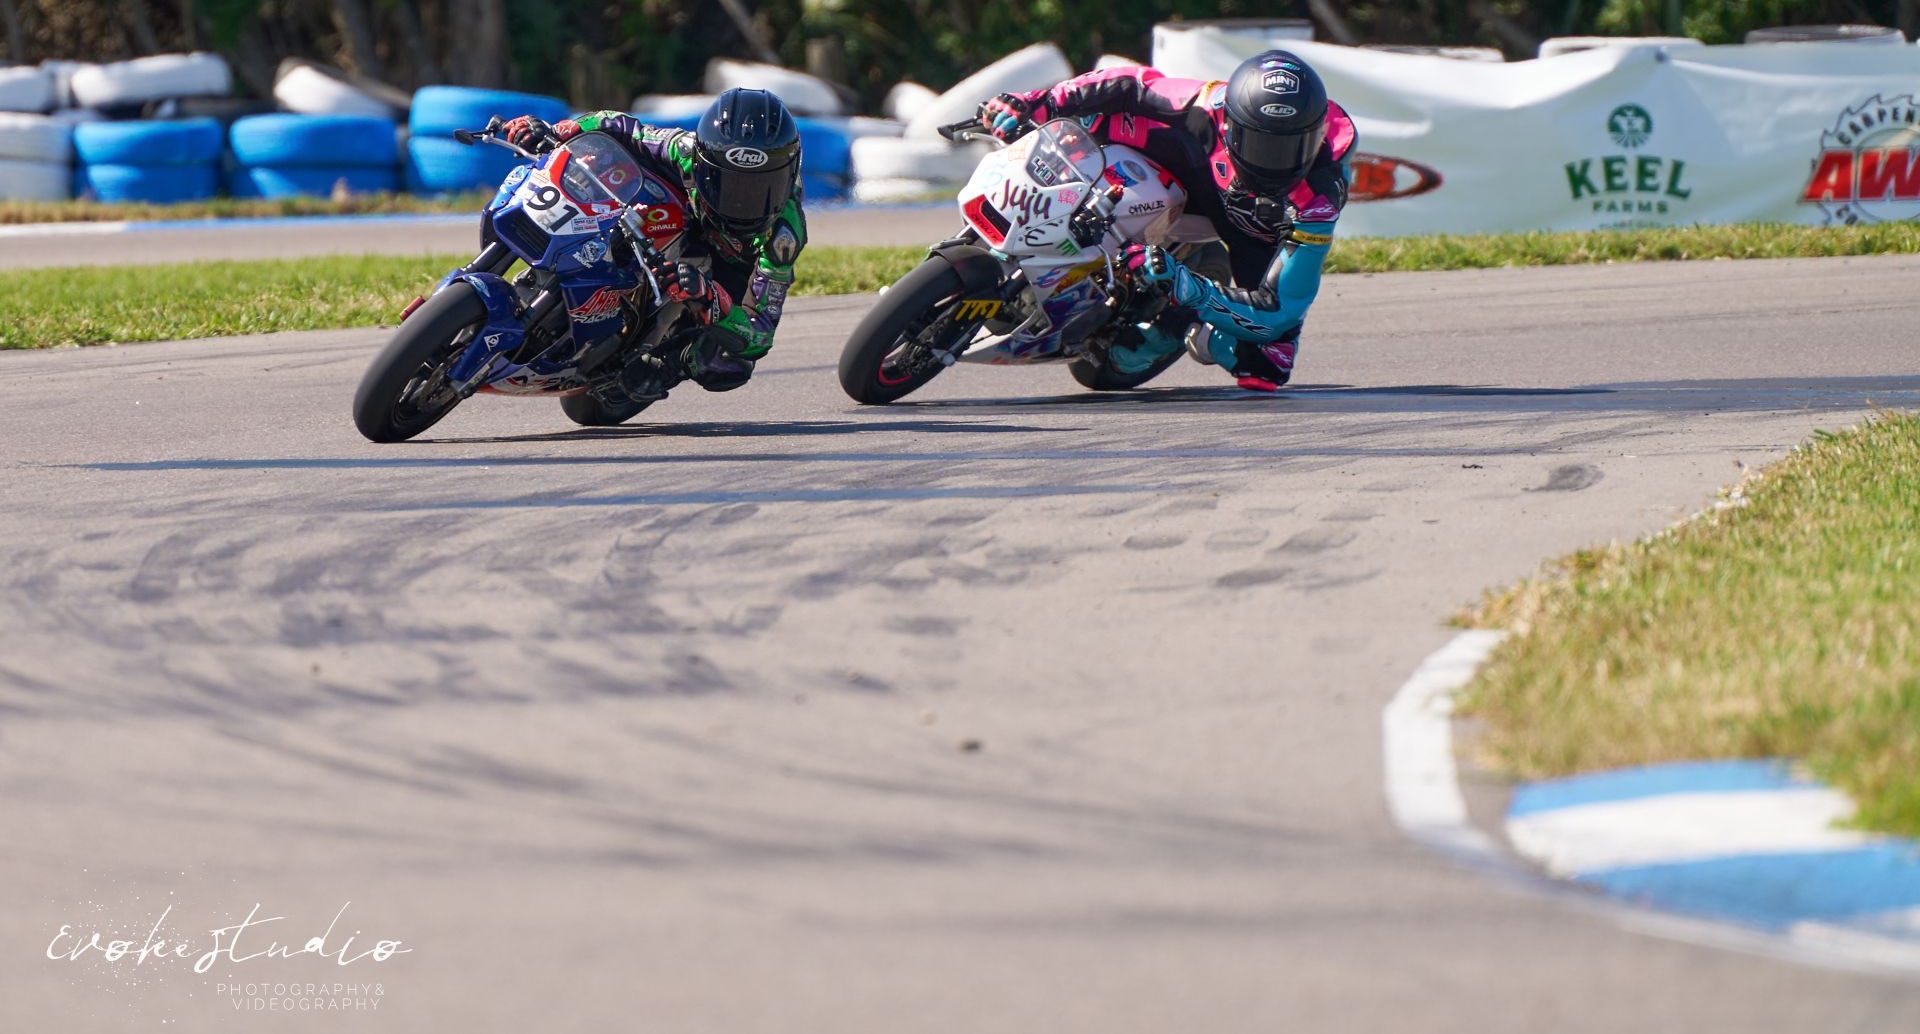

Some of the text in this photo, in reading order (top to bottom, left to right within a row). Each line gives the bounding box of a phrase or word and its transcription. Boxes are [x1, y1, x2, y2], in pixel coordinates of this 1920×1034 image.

[1265, 75, 1296, 88] MINT
[1265, 105, 1292, 114] HJC
[729, 149, 764, 163] Arai
[1564, 154, 1693, 200] KEEL
[526, 185, 580, 233] 91
[1592, 200, 1669, 214] FARMS
[647, 223, 678, 233] OHVALE
